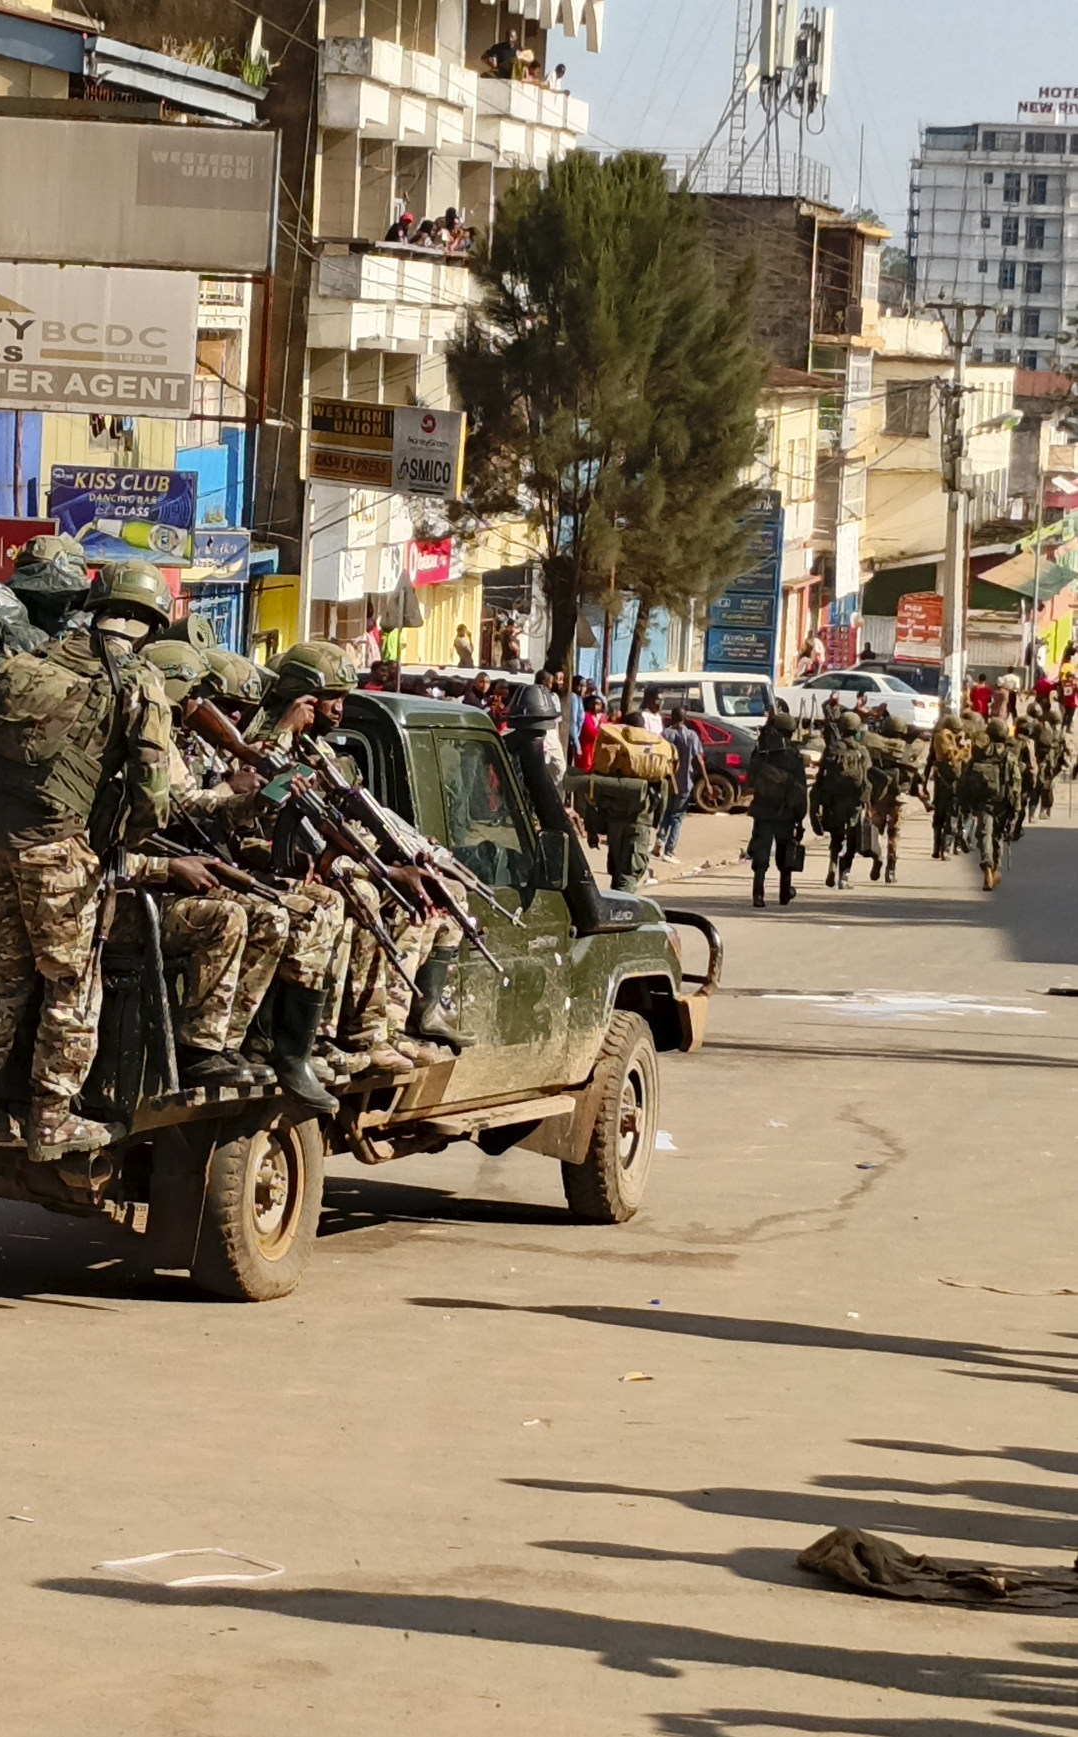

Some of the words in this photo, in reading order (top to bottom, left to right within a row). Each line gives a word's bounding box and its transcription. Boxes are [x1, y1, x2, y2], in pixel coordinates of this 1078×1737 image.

[1018, 101, 1053, 113] NEW
[151, 151, 250, 166] WESTERN
[182, 165, 249, 180] UNION
[41, 320, 167, 349] BCDC
[63, 373, 185, 401] AGENT
[313, 404, 382, 422] WESTERN
[334, 420, 382, 436] UNION
[409, 458, 451, 484] SMICO
[74, 471, 117, 489] KISS
[121, 474, 170, 492] CLUB
[114, 506, 150, 517] CLASS
